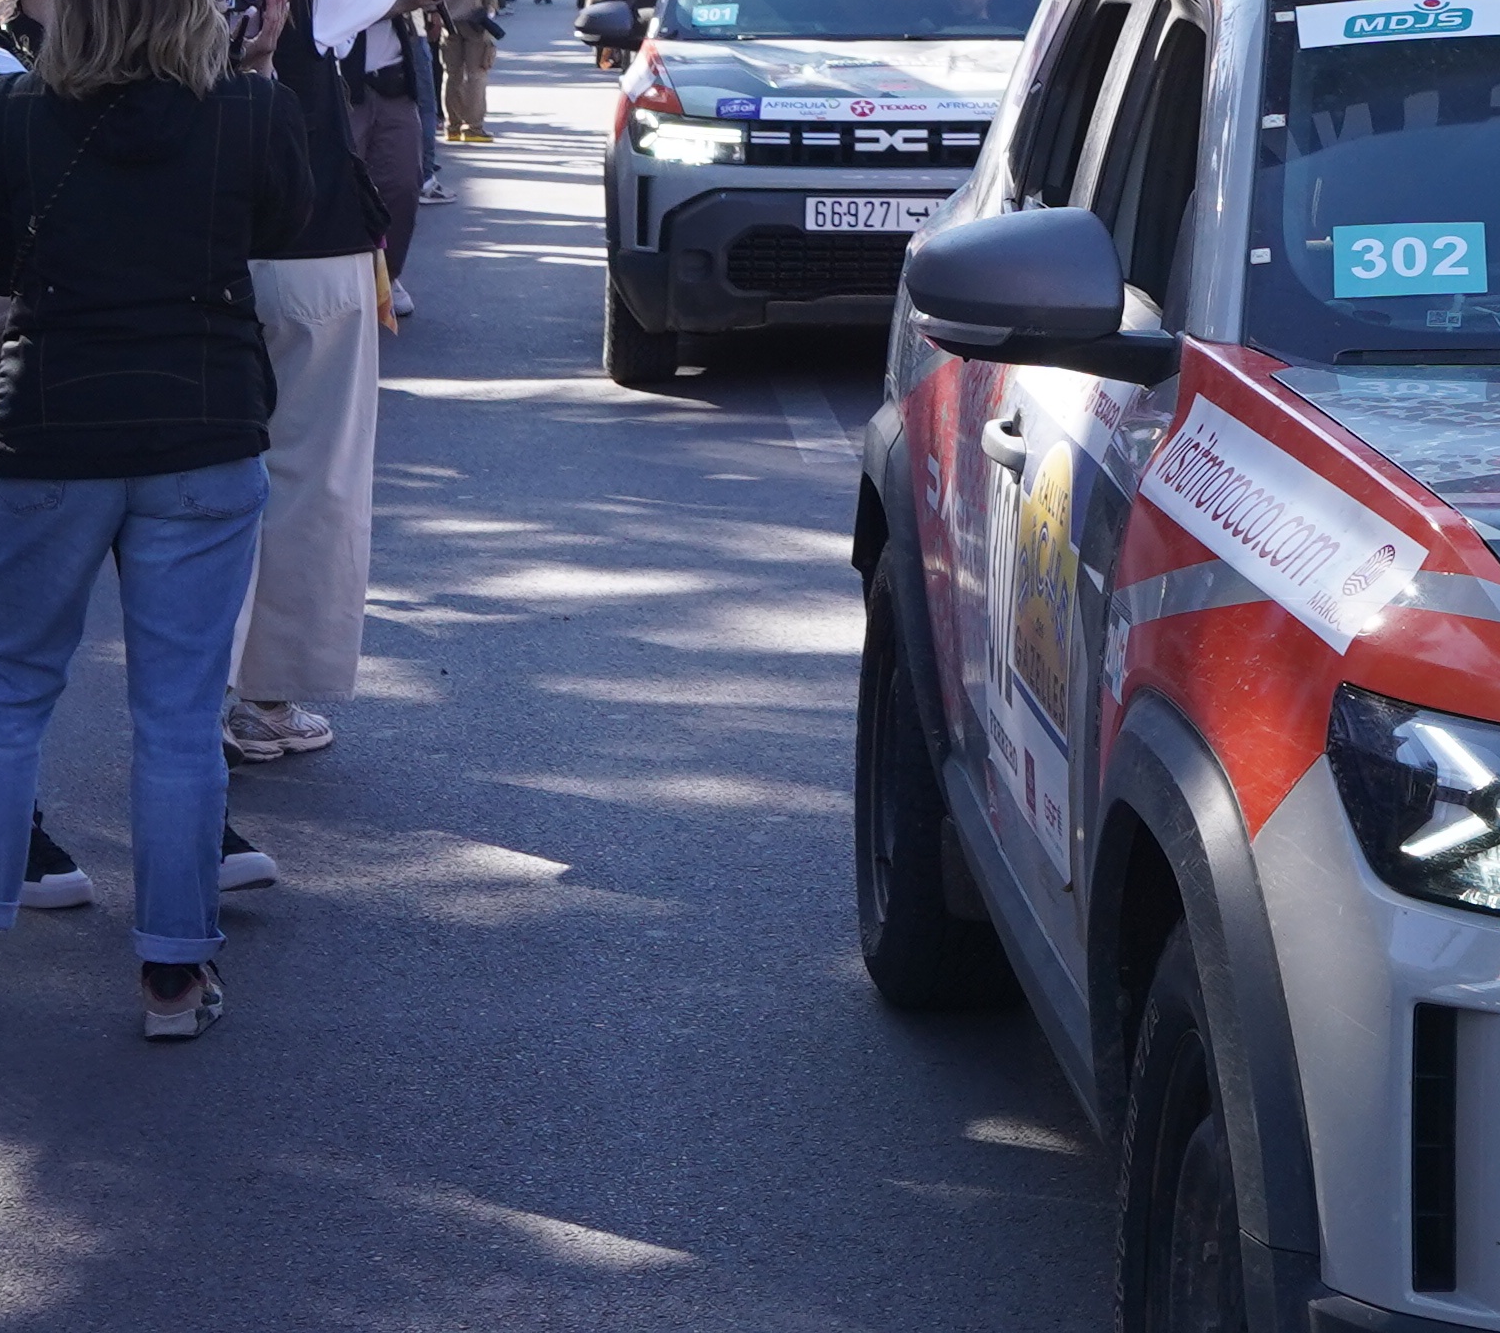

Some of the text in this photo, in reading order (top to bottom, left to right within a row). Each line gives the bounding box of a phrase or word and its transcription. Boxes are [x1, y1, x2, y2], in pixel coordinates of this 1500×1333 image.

[698, 7, 732, 22] 301
[1353, 11, 1464, 33] MDJS
[815, 200, 891, 228] 66927
[1349, 234, 1470, 279] 302
